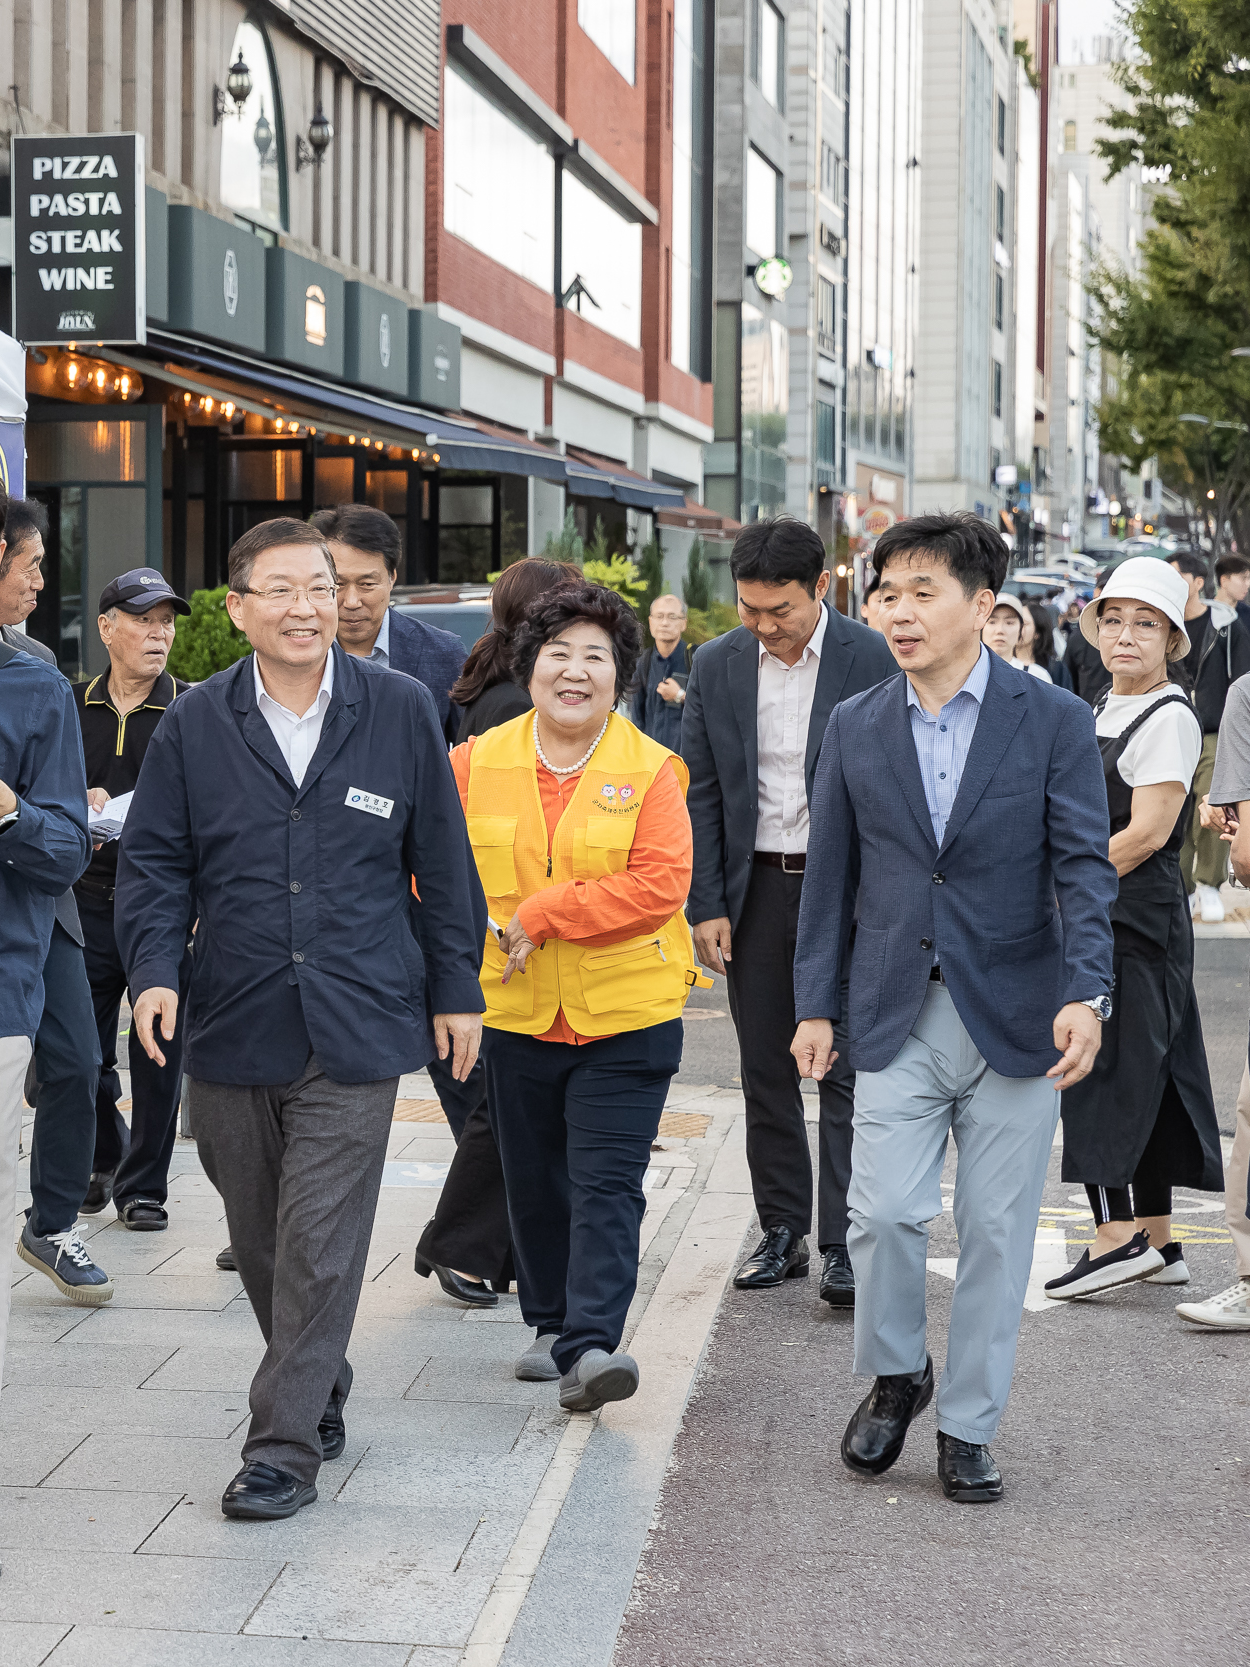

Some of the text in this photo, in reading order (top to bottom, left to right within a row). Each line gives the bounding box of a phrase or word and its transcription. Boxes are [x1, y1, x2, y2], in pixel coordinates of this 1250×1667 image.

[32, 155, 118, 180] PIZZA
[29, 192, 122, 217] PASTA
[29, 229, 123, 254] STEAK
[38, 266, 115, 291] WINE
